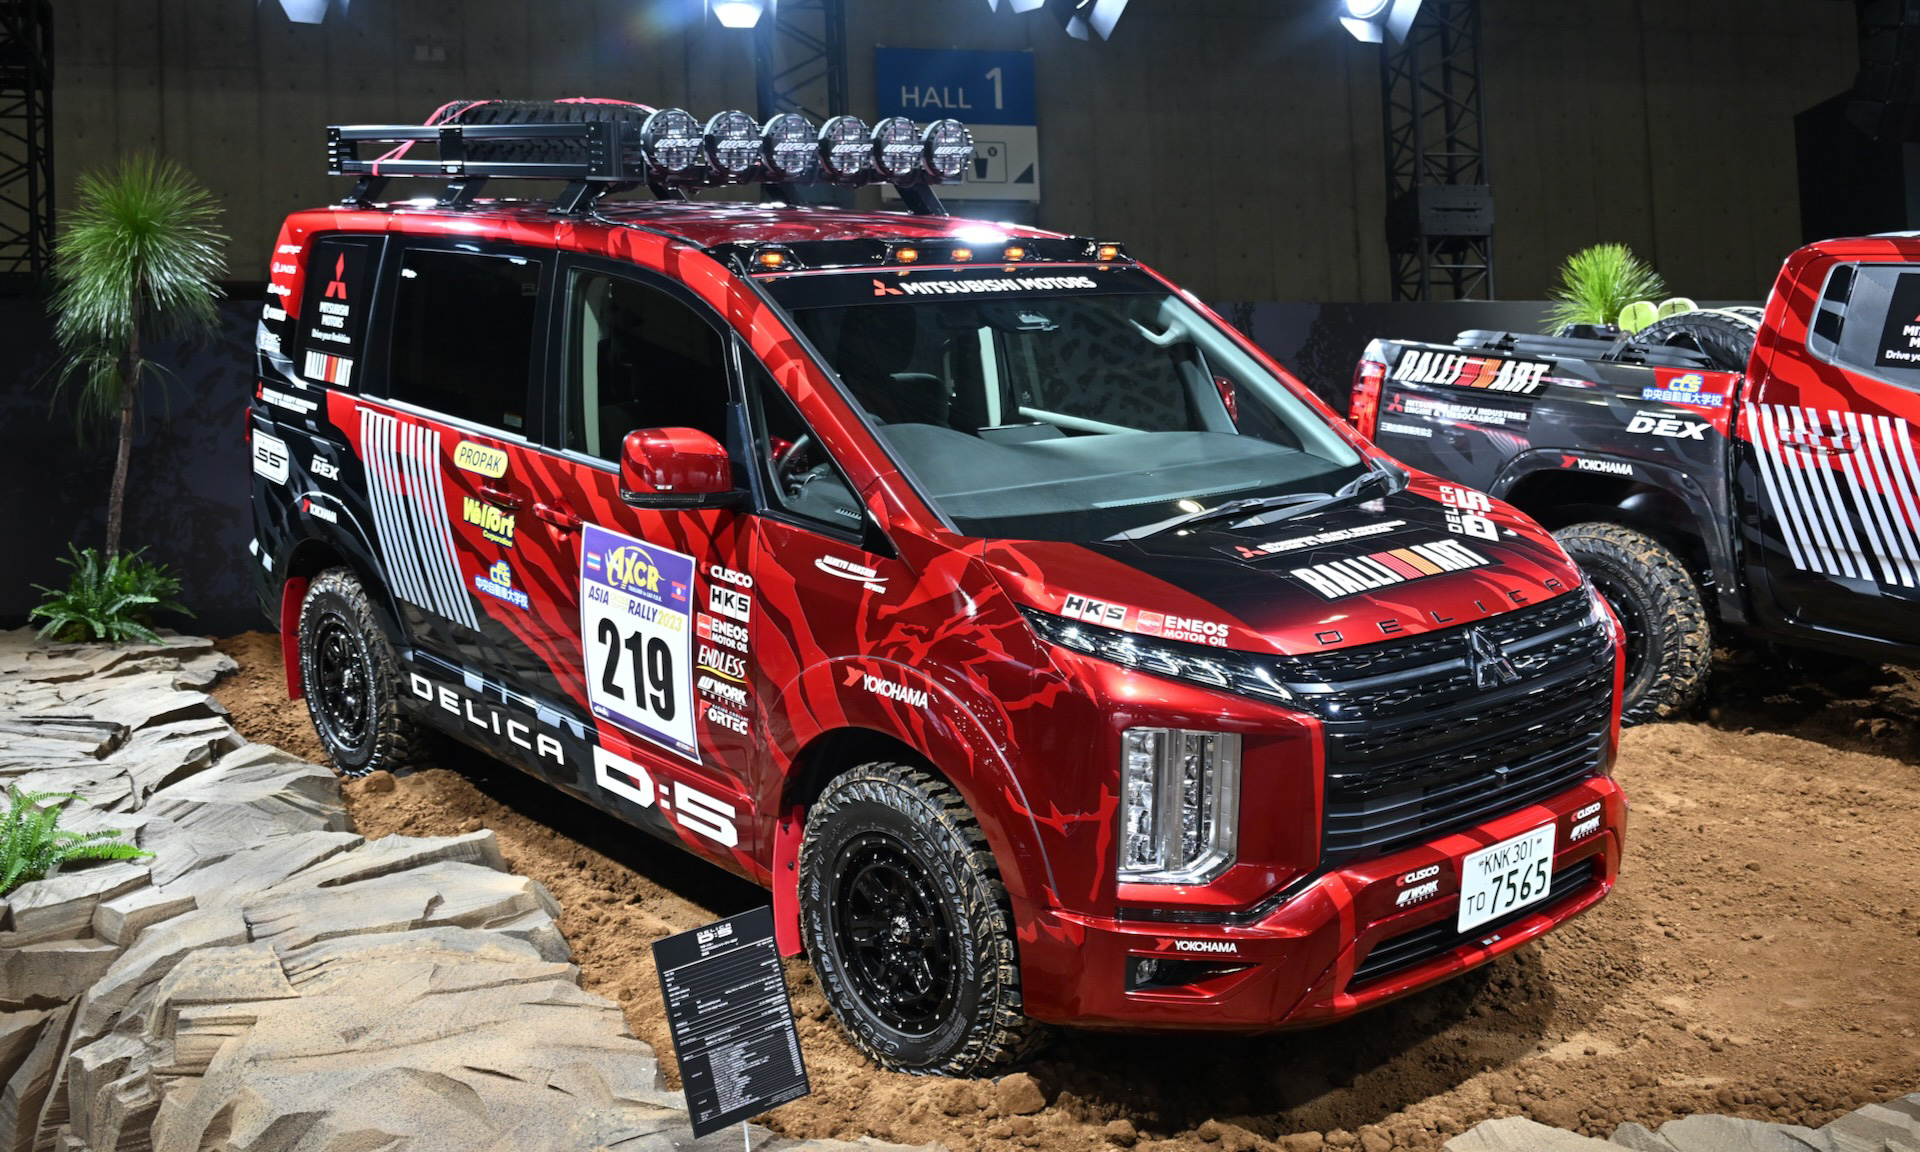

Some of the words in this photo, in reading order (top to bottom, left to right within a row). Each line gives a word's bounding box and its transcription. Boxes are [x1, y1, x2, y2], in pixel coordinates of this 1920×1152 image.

[901, 86, 972, 109] HALL
[985, 67, 1004, 110] 1
[900, 278, 1022, 295] MITSUBISHI
[1016, 277, 1097, 292] MOTORS
[1885, 350, 1910, 360] Drive
[1642, 388, 1722, 406] 中央自動車大学校
[1404, 407, 1433, 416] ENGINE
[1451, 404, 1477, 414] HEAVY
[1478, 406, 1527, 421] INDUSTRIES
[1626, 416, 1712, 440] DEX
[311, 459, 339, 481] DEX
[459, 446, 502, 473] PROPAK
[1578, 458, 1633, 475] YOKOHAMA
[1439, 486, 1464, 534] DELICA
[710, 564, 754, 588] CUSCO
[588, 586, 609, 605] ASIA
[628, 600, 658, 622] RALLY
[657, 610, 683, 632] 2023
[710, 586, 750, 616] HKS
[1065, 596, 1126, 620] HKS
[1314, 578, 1571, 646] DELICA
[712, 617, 749, 643] ENEOS
[1163, 629, 1206, 644] MOTOR
[1208, 635, 1228, 647] OIL
[1164, 615, 1229, 637] ENEOS
[711, 633, 737, 650] MOTOR
[736, 641, 749, 653] OIL
[598, 617, 676, 721] 219
[698, 644, 747, 678] ENDLESS
[711, 680, 748, 706] WORK
[863, 673, 929, 708] YOKOHAMA
[410, 672, 565, 766] DELICA
[593, 744, 738, 848] D:5
[1483, 847, 1511, 876] KNK
[1512, 838, 1533, 864] 301
[1405, 865, 1440, 884] CUSCO
[1491, 856, 1549, 914] 7565
[1175, 940, 1238, 953] YOKOHAMA
